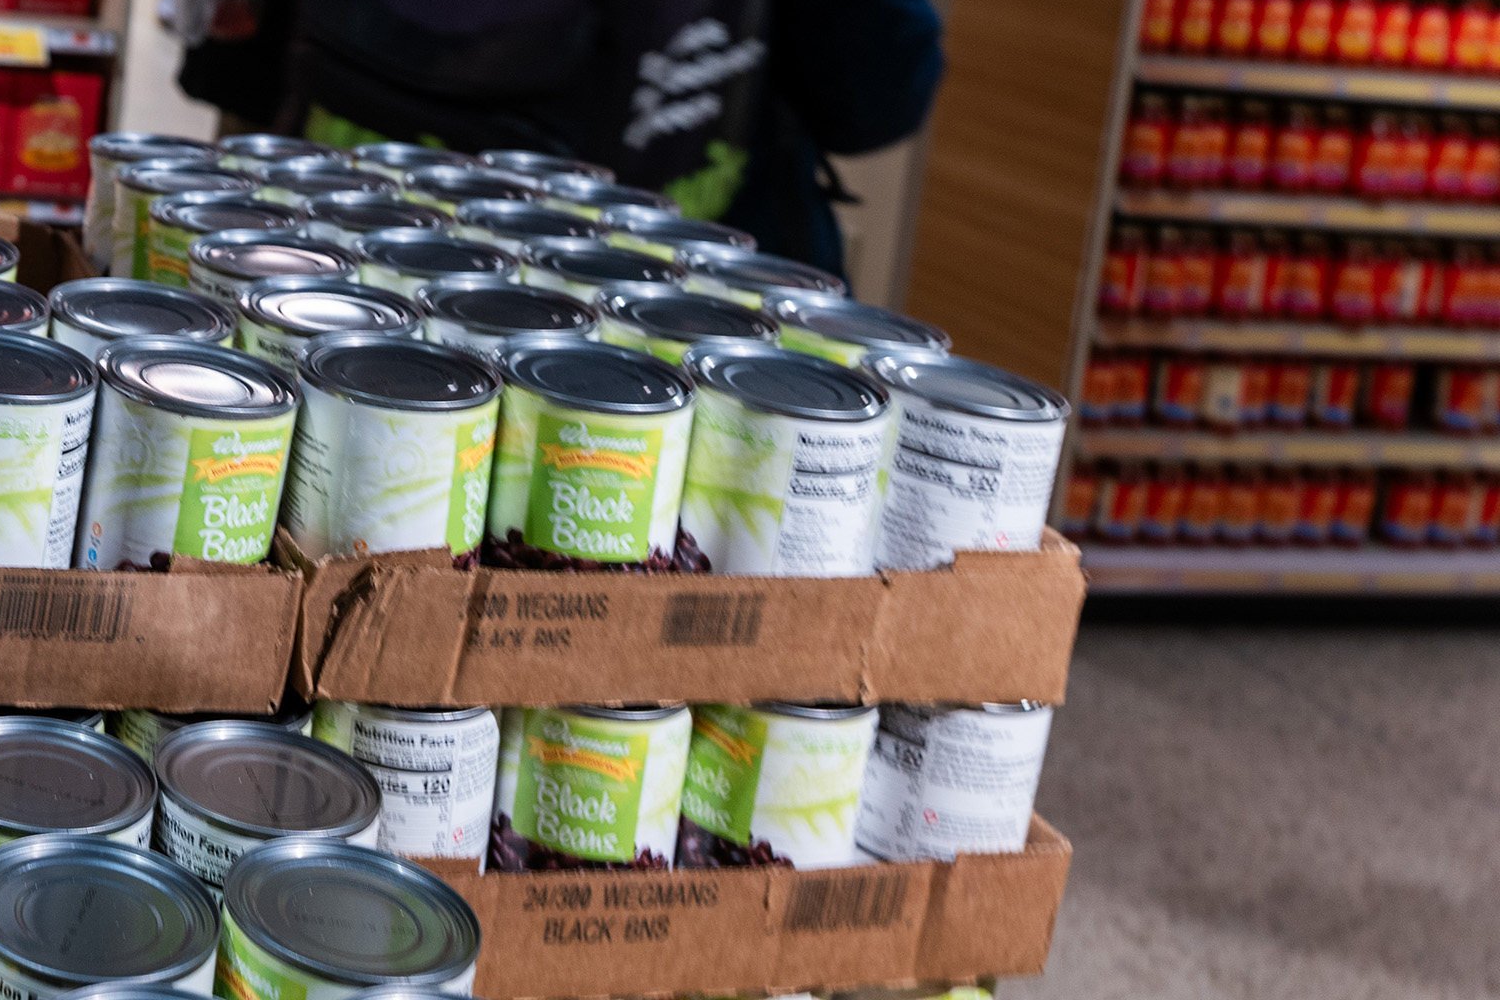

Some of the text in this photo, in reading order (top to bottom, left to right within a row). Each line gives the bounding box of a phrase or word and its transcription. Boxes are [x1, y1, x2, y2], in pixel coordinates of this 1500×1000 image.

[200, 491, 269, 528] Black
[548, 480, 635, 523] Black
[198, 528, 266, 562] Beans
[548, 513, 635, 555] Beans
[517, 592, 610, 620] WEGMANS
[354, 721, 456, 748] Nutrition Facts
[534, 772, 617, 825] Black
[533, 805, 618, 854] Beans
[603, 880, 720, 909] WEGMANS
[543, 914, 671, 944] BLACK BNS
